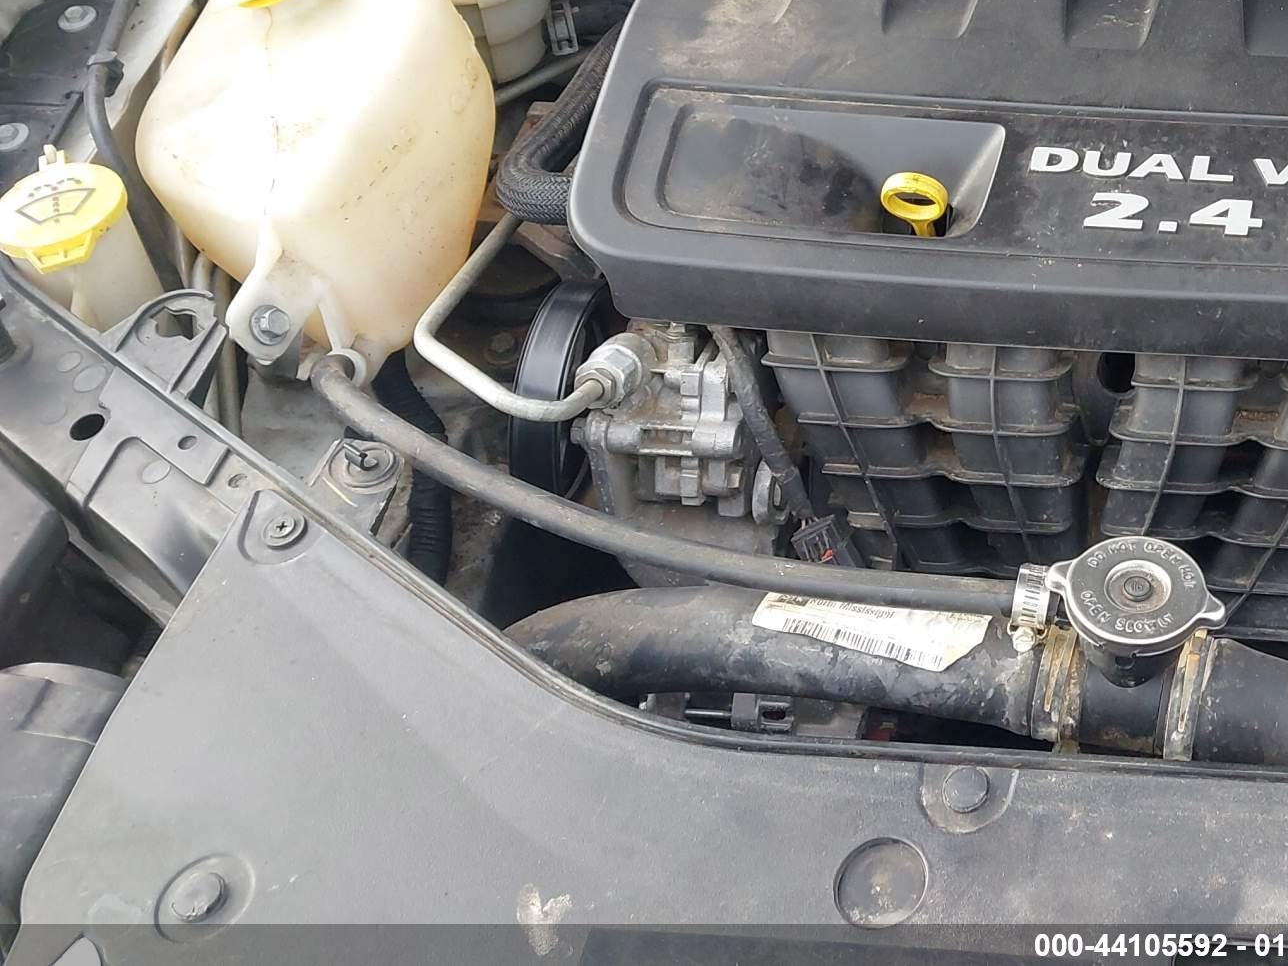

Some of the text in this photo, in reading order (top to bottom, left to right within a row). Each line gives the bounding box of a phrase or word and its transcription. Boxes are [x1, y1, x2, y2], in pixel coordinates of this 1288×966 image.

[1029, 146, 1234, 182] DUAL
[1087, 541, 1197, 589] DO NOT OPEN HOT
[1080, 590, 1175, 634] OPEN SLOWLY
